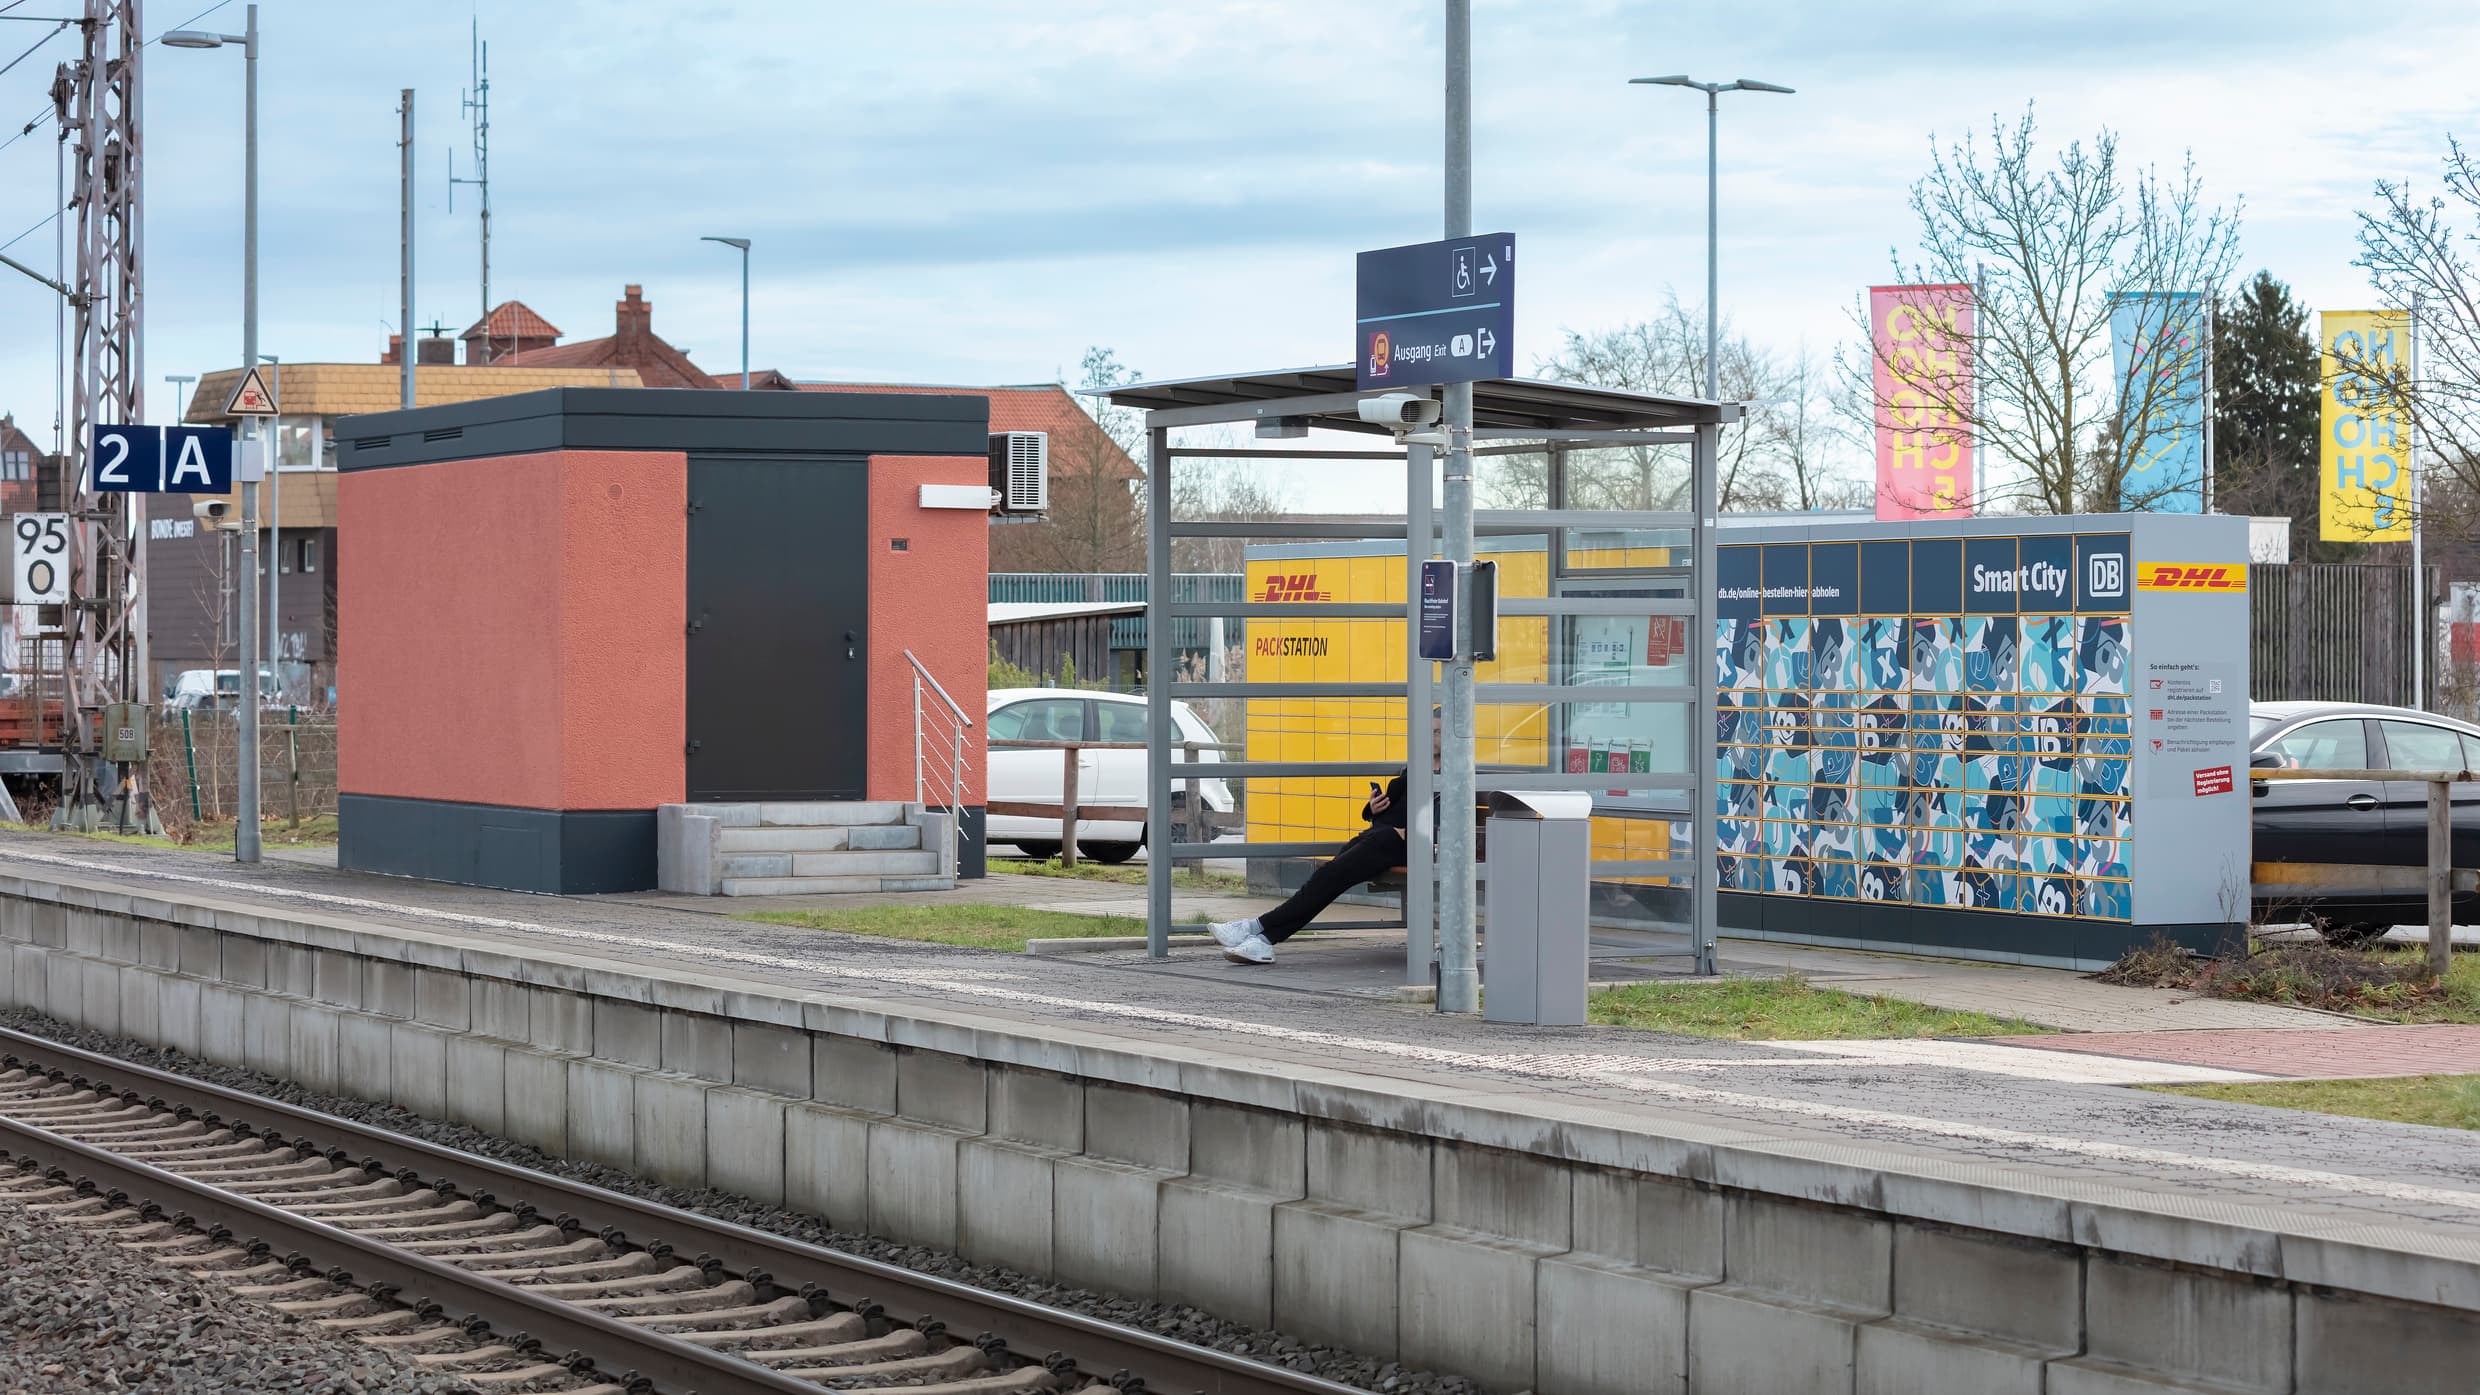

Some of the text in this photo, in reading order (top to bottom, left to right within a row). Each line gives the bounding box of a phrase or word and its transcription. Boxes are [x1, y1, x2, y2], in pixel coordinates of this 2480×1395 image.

[1394, 344, 1432, 363] Ausgang
[1434, 344, 1447, 357] Exit
[99, 433, 130, 483] 2
[171, 435, 212, 485] A
[16, 517, 66, 555] 95
[27, 558, 55, 596] 0
[1264, 573, 1321, 602] DHL
[1973, 560, 2068, 598] Smart City
[2093, 560, 2120, 591] DB
[2152, 567, 2235, 589] DHL
[1255, 637, 1328, 657] PACKSTATION
[2180, 663, 2200, 672] geht's:
[119, 729, 135, 739] 508
[2196, 770, 2216, 779] Versand
